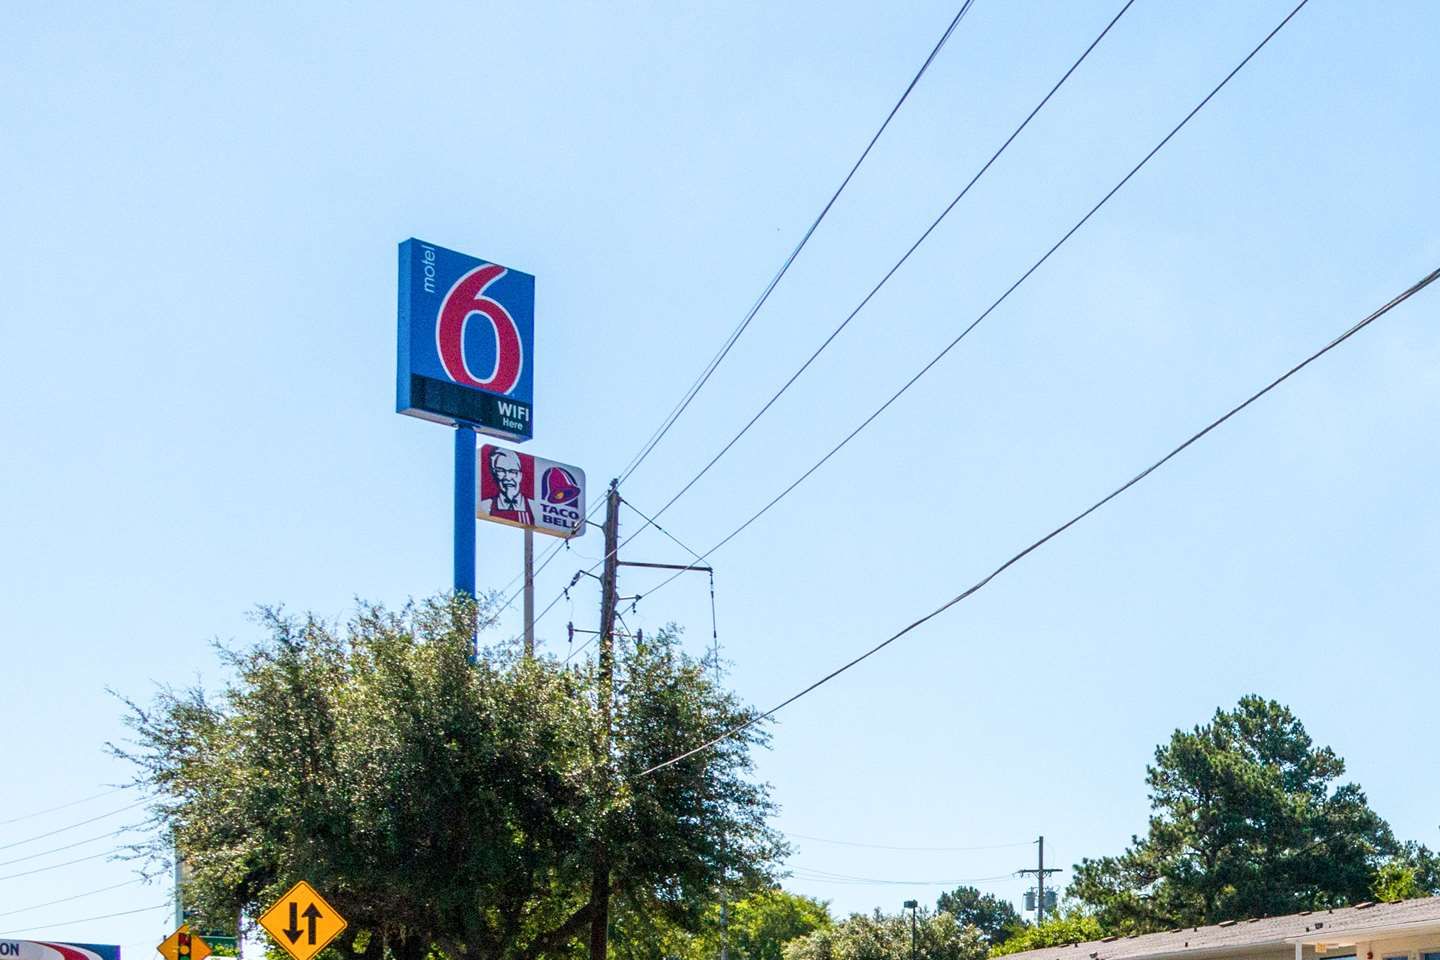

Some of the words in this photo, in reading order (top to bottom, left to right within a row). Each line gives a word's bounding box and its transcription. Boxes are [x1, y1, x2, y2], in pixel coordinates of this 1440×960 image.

[421, 244, 436, 293] motel
[436, 262, 523, 395] 6
[498, 401, 529, 421] WIFI
[503, 417, 523, 430] Here
[541, 504, 579, 519] TACO
[543, 514, 578, 528] BELL
